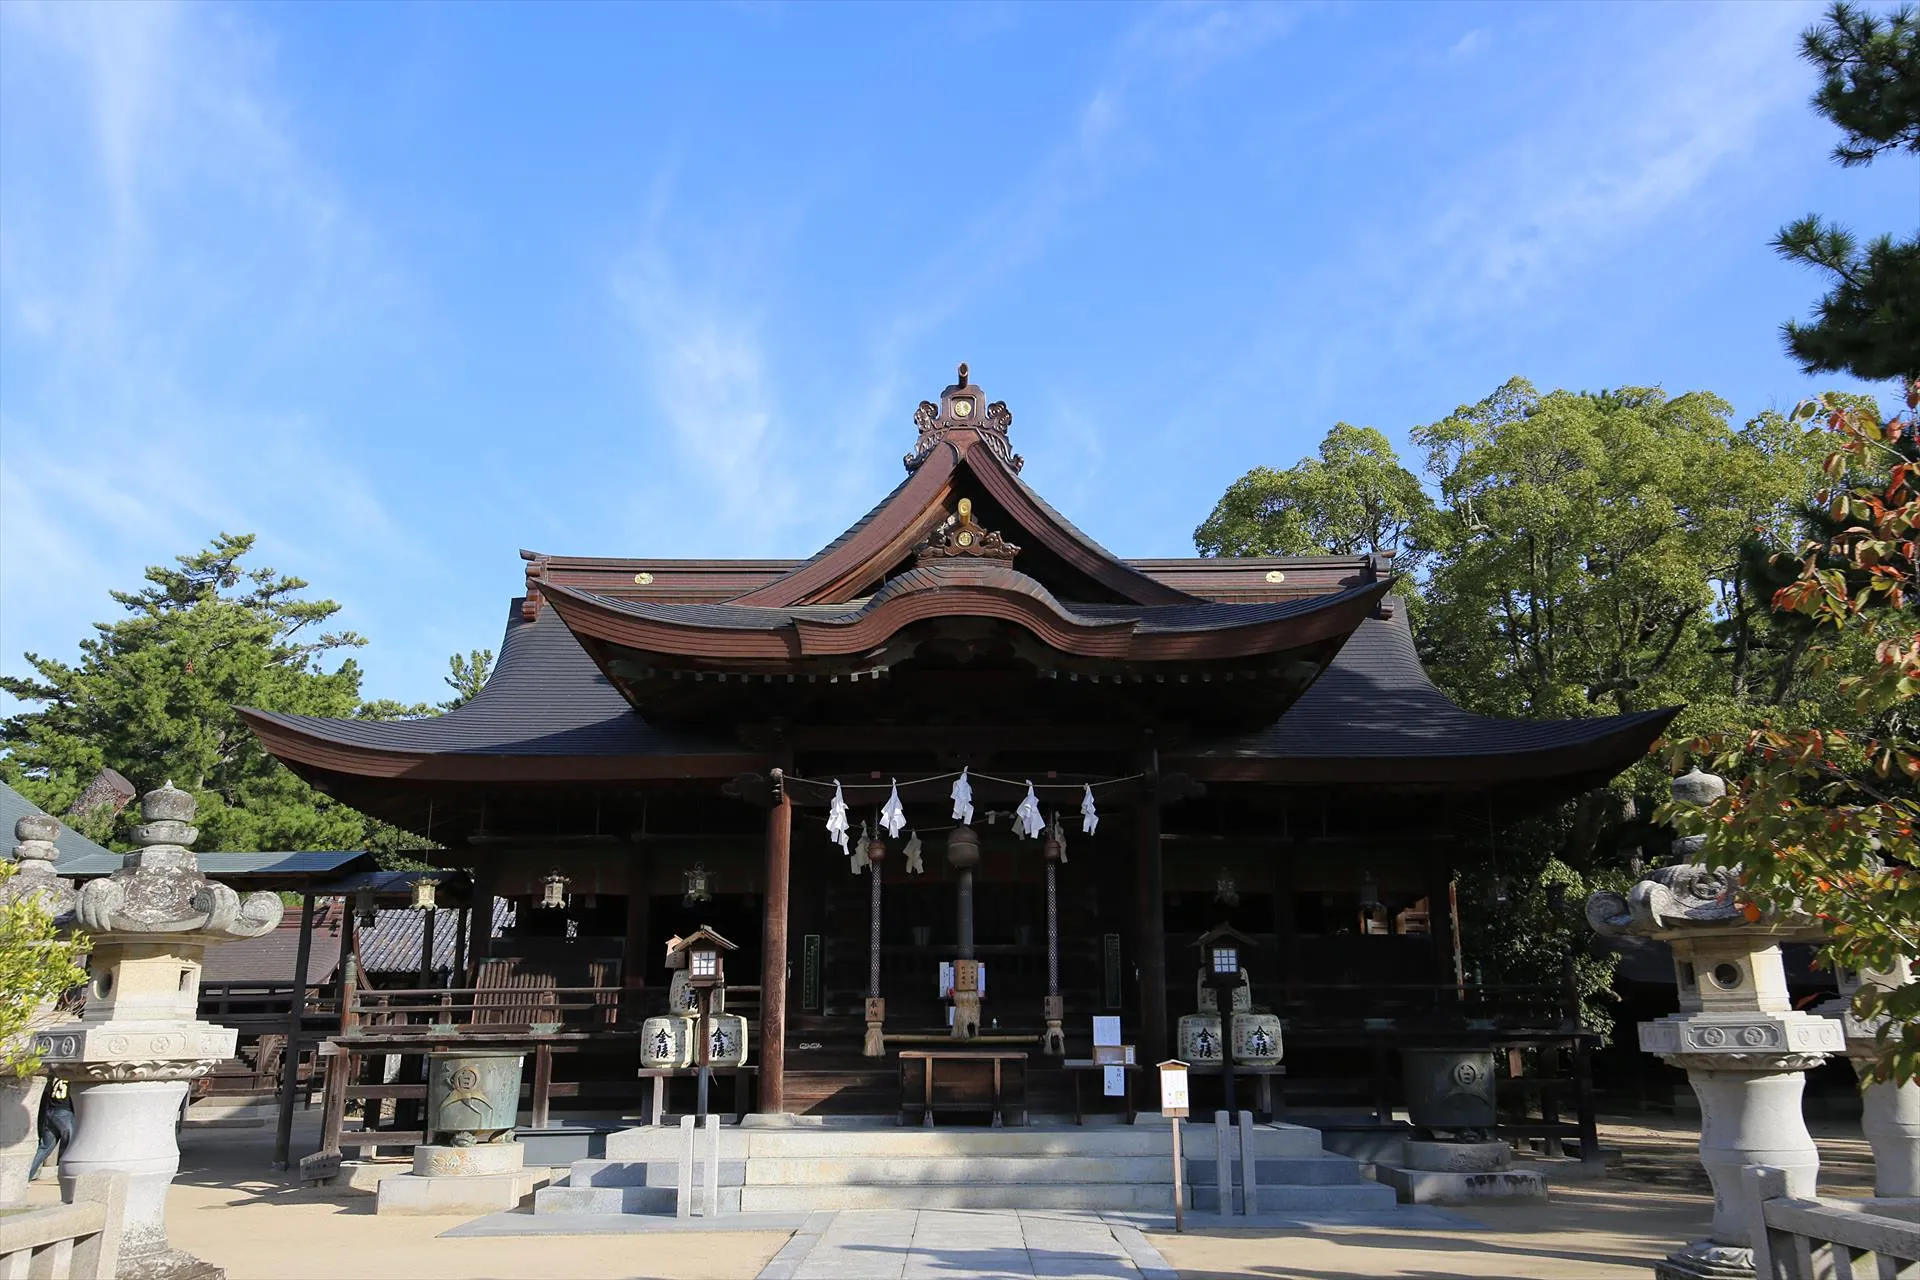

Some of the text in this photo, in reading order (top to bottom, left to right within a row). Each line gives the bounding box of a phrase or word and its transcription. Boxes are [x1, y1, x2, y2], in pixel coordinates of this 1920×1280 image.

[655, 1027, 673, 1059] 金陵
[710, 1026, 730, 1058] 金陵
[1197, 1027, 1216, 1059] 金陵
[1251, 1025, 1271, 1057] 金陵
